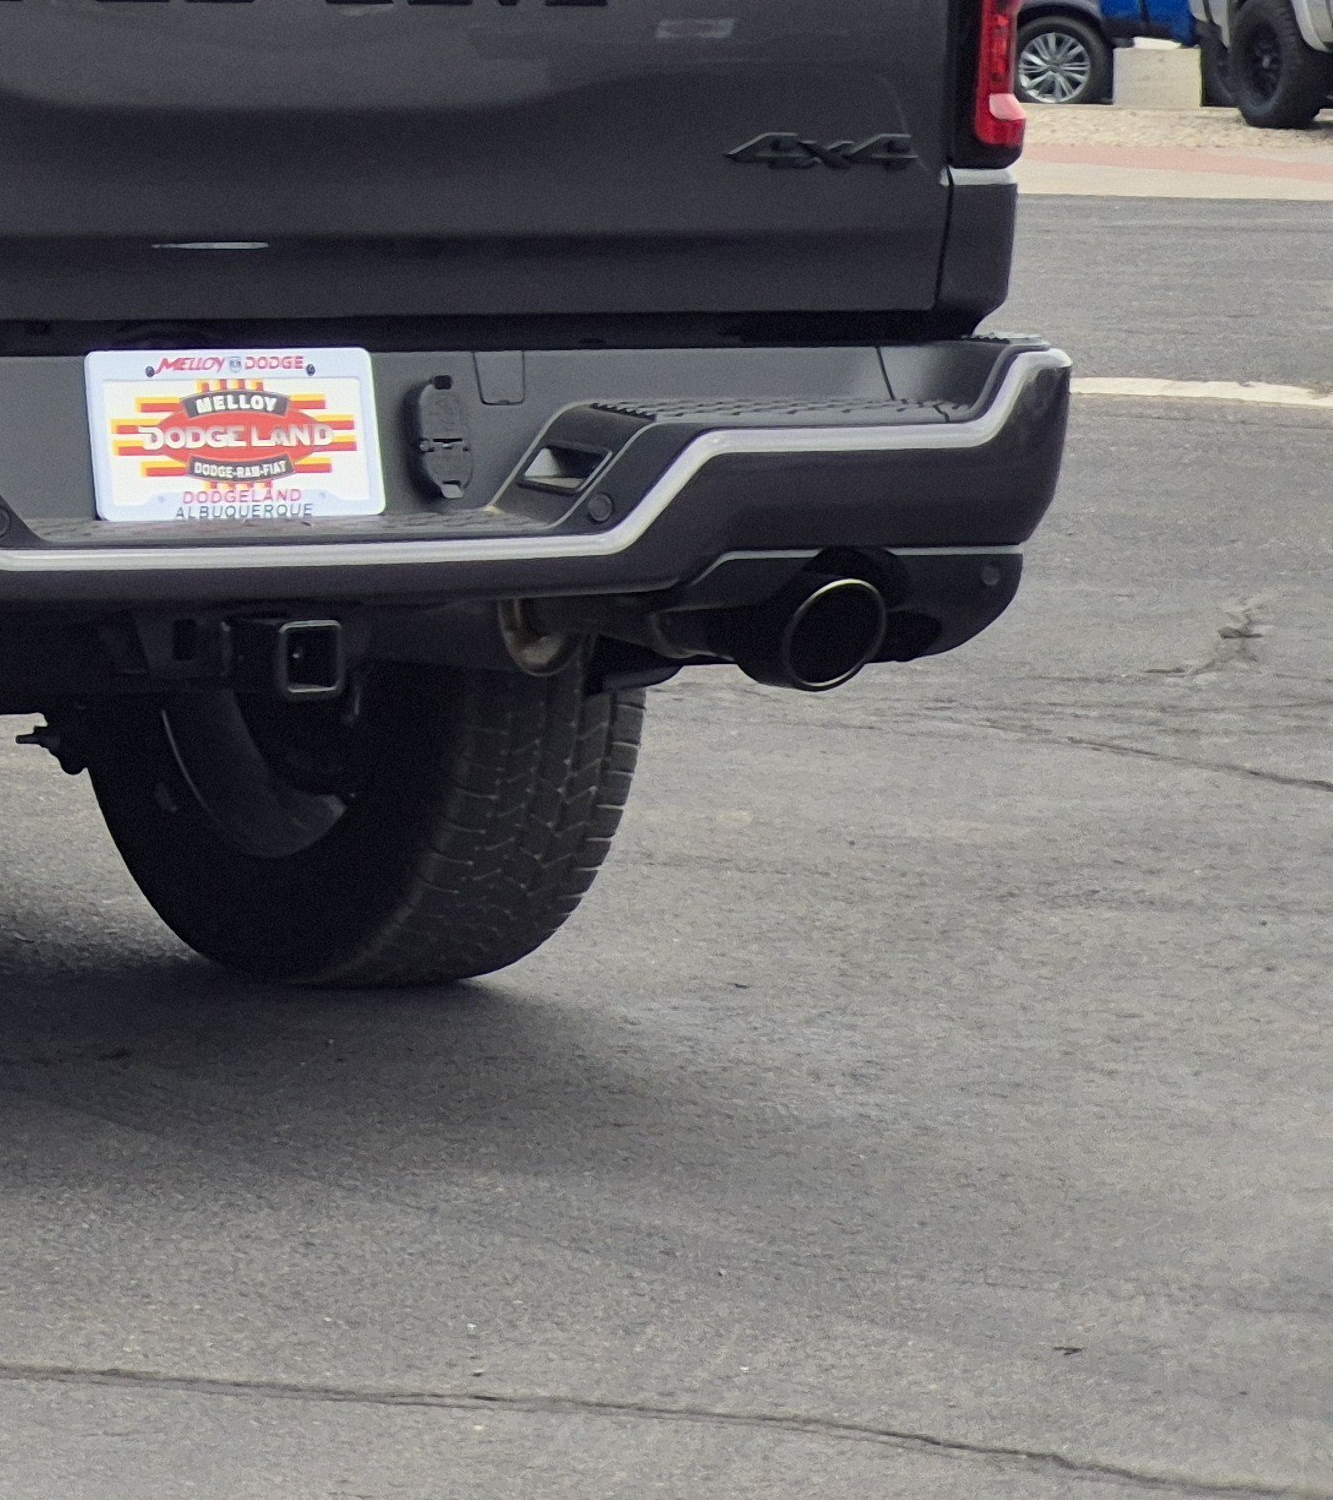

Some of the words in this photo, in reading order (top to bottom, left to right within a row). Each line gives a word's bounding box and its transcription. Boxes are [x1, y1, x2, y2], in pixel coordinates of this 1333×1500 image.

[154, 357, 224, 375] MELLOY
[244, 356, 304, 370] DODGE
[195, 394, 277, 414] MELLOY
[183, 488, 302, 505] DODGELAND
[175, 503, 314, 520] ALBUQUERQUE
